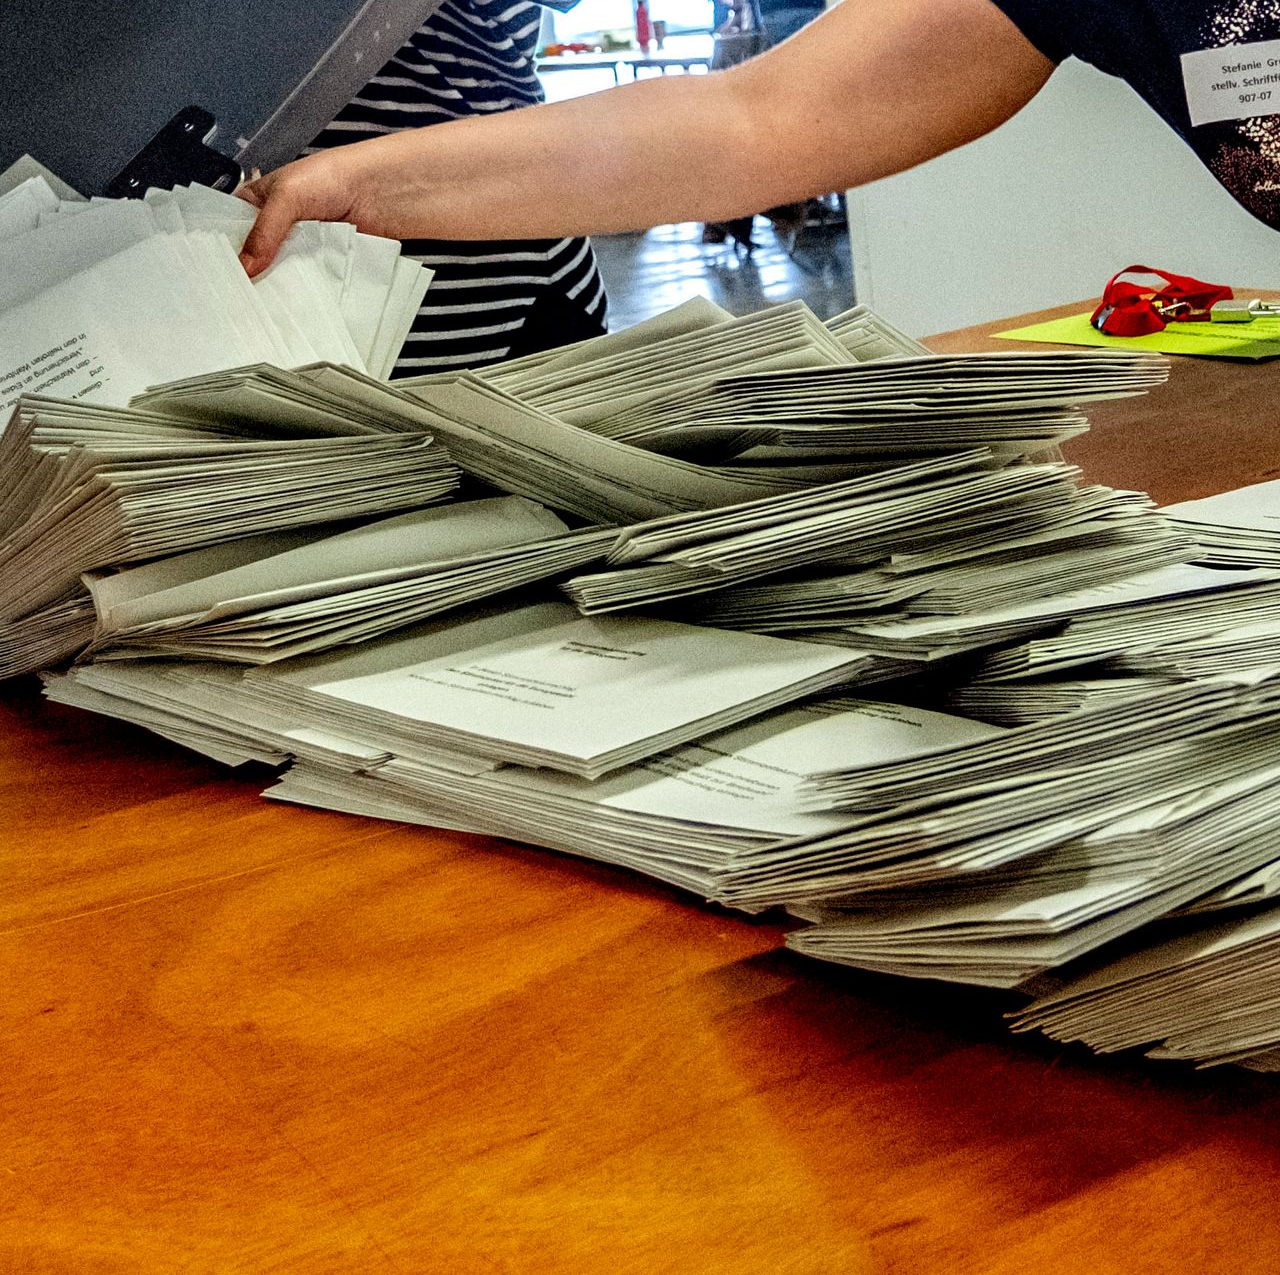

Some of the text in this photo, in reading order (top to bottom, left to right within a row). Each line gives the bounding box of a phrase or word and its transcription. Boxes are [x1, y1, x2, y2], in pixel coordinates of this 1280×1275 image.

[1221, 60, 1262, 74] Stefanie
[1211, 79, 1240, 91] stellv.
[1239, 90, 1272, 103] 907-07
[89, 366, 104, 377] und
[34, 368, 75, 392] Wahlschein
[78, 381, 102, 397] diesen
